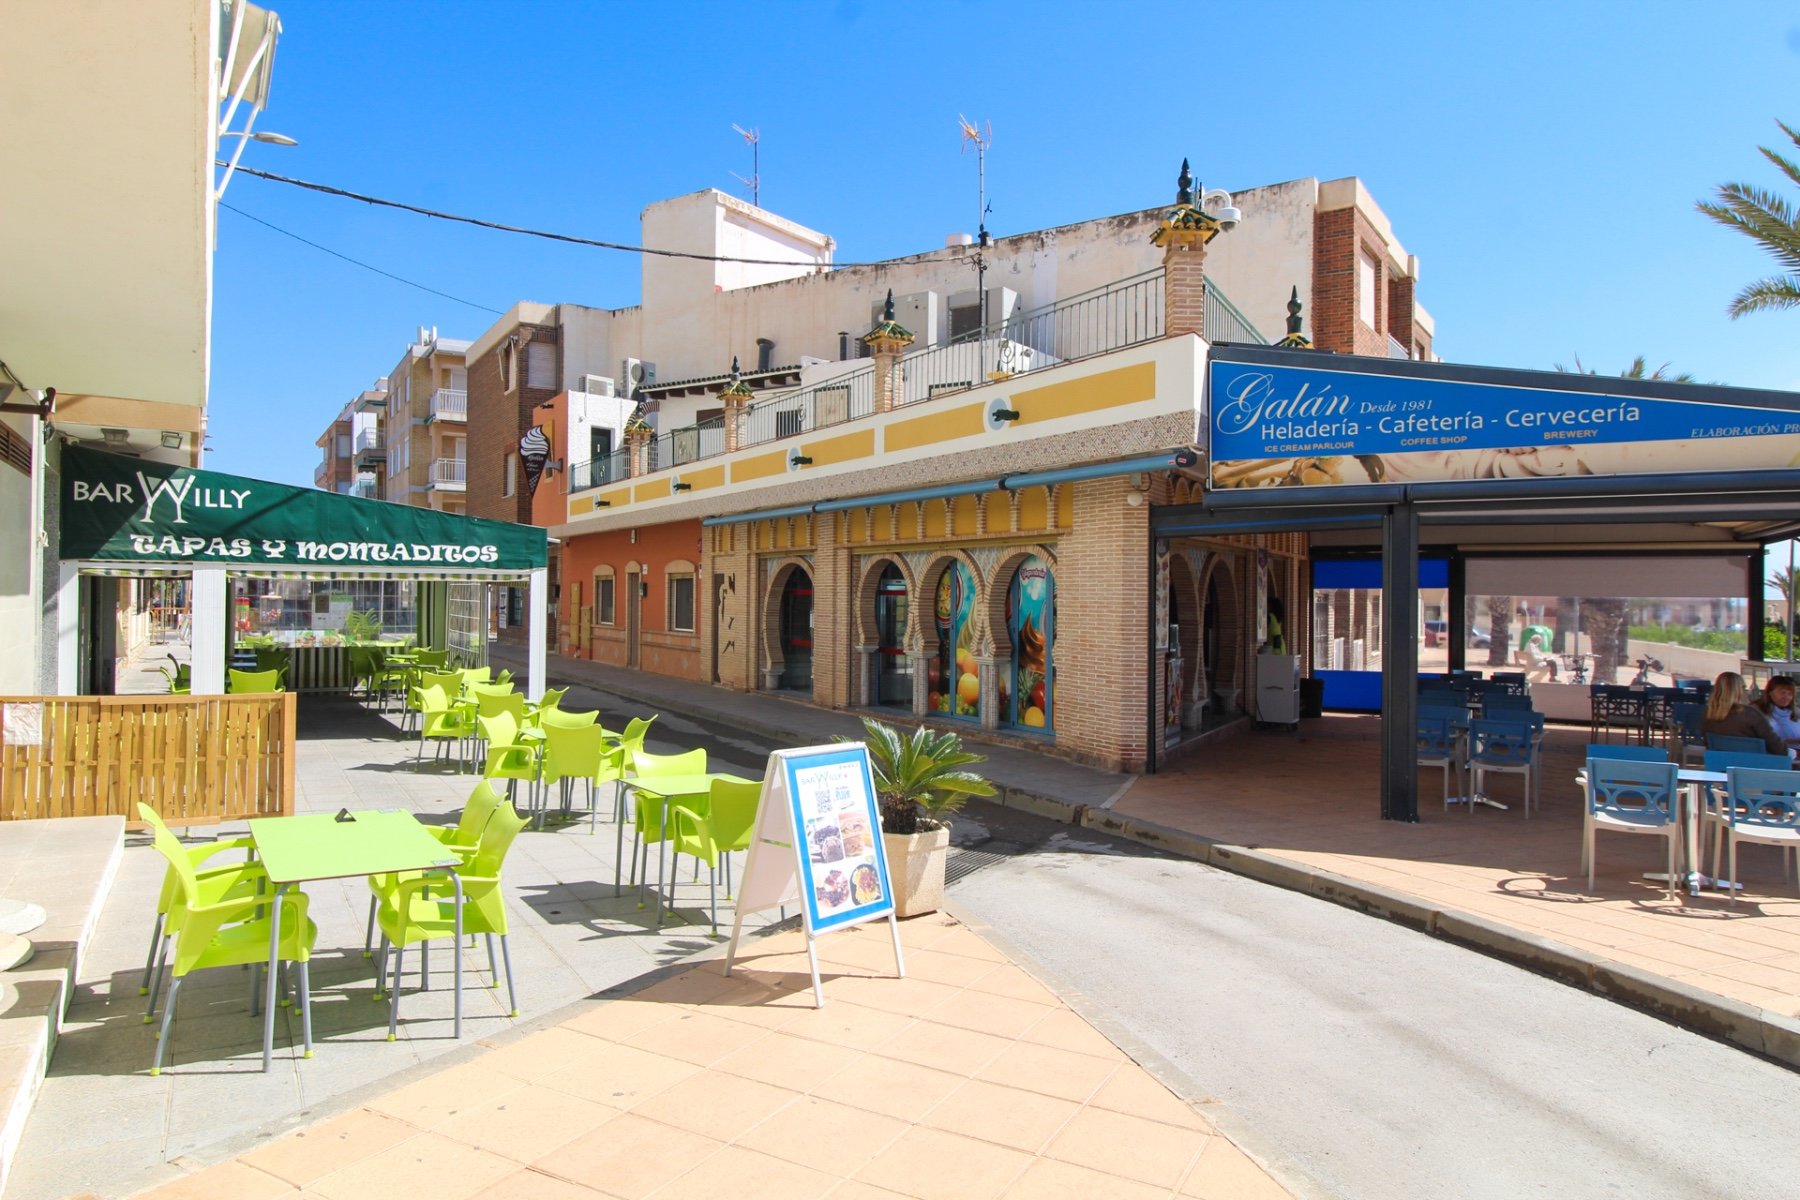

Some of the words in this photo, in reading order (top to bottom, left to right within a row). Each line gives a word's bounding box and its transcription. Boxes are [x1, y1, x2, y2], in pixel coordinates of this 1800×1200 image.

[1216, 372, 1354, 435] Galán
[1359, 402, 1396, 414] Desde
[1401, 399, 1433, 412] 1981
[1261, 418, 1359, 440] Heladería
[1378, 411, 1484, 434] Cafetería
[1505, 402, 1641, 428] Cervecería
[1690, 422, 1780, 438] ELABORACIÓN
[1400, 437, 1439, 447] COFFEE
[1440, 435, 1468, 445] SHOP
[1543, 429, 1599, 440] BREWERY
[1264, 445, 1278, 453] ICE
[1280, 443, 1311, 452] CREAM
[1313, 441, 1354, 451] PARLOUR
[73, 480, 134, 504] BAR
[136, 471, 252, 524] WILLY
[130, 534, 252, 557] TAPAS
[262, 539, 286, 559] Y
